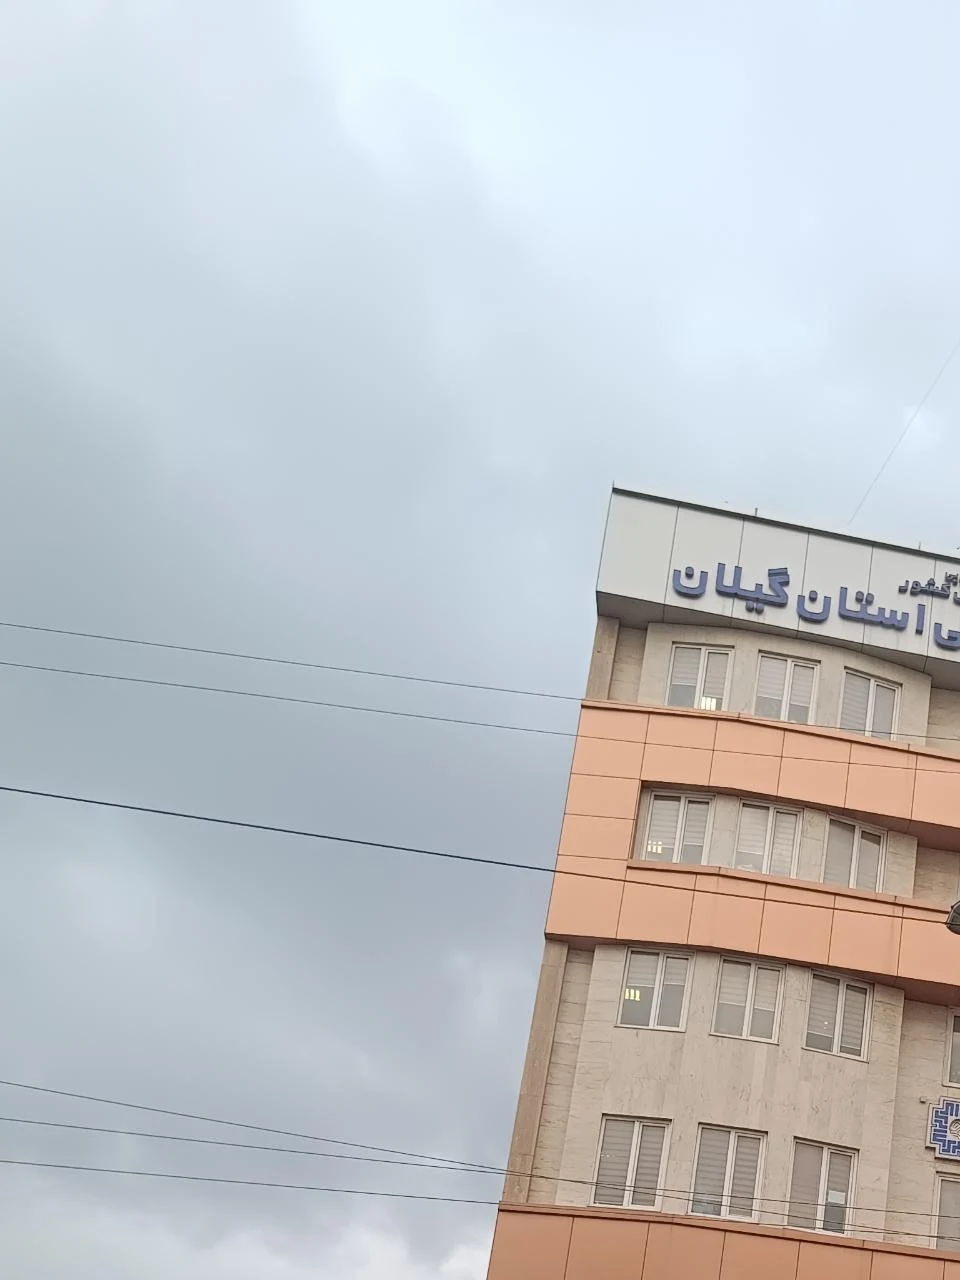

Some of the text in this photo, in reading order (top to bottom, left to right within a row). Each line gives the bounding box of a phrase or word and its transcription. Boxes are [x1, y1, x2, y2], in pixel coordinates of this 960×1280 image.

[671, 562, 790, 615] گیلان
[796, 585, 926, 636] استان
[899, 577, 951, 599] کشور
